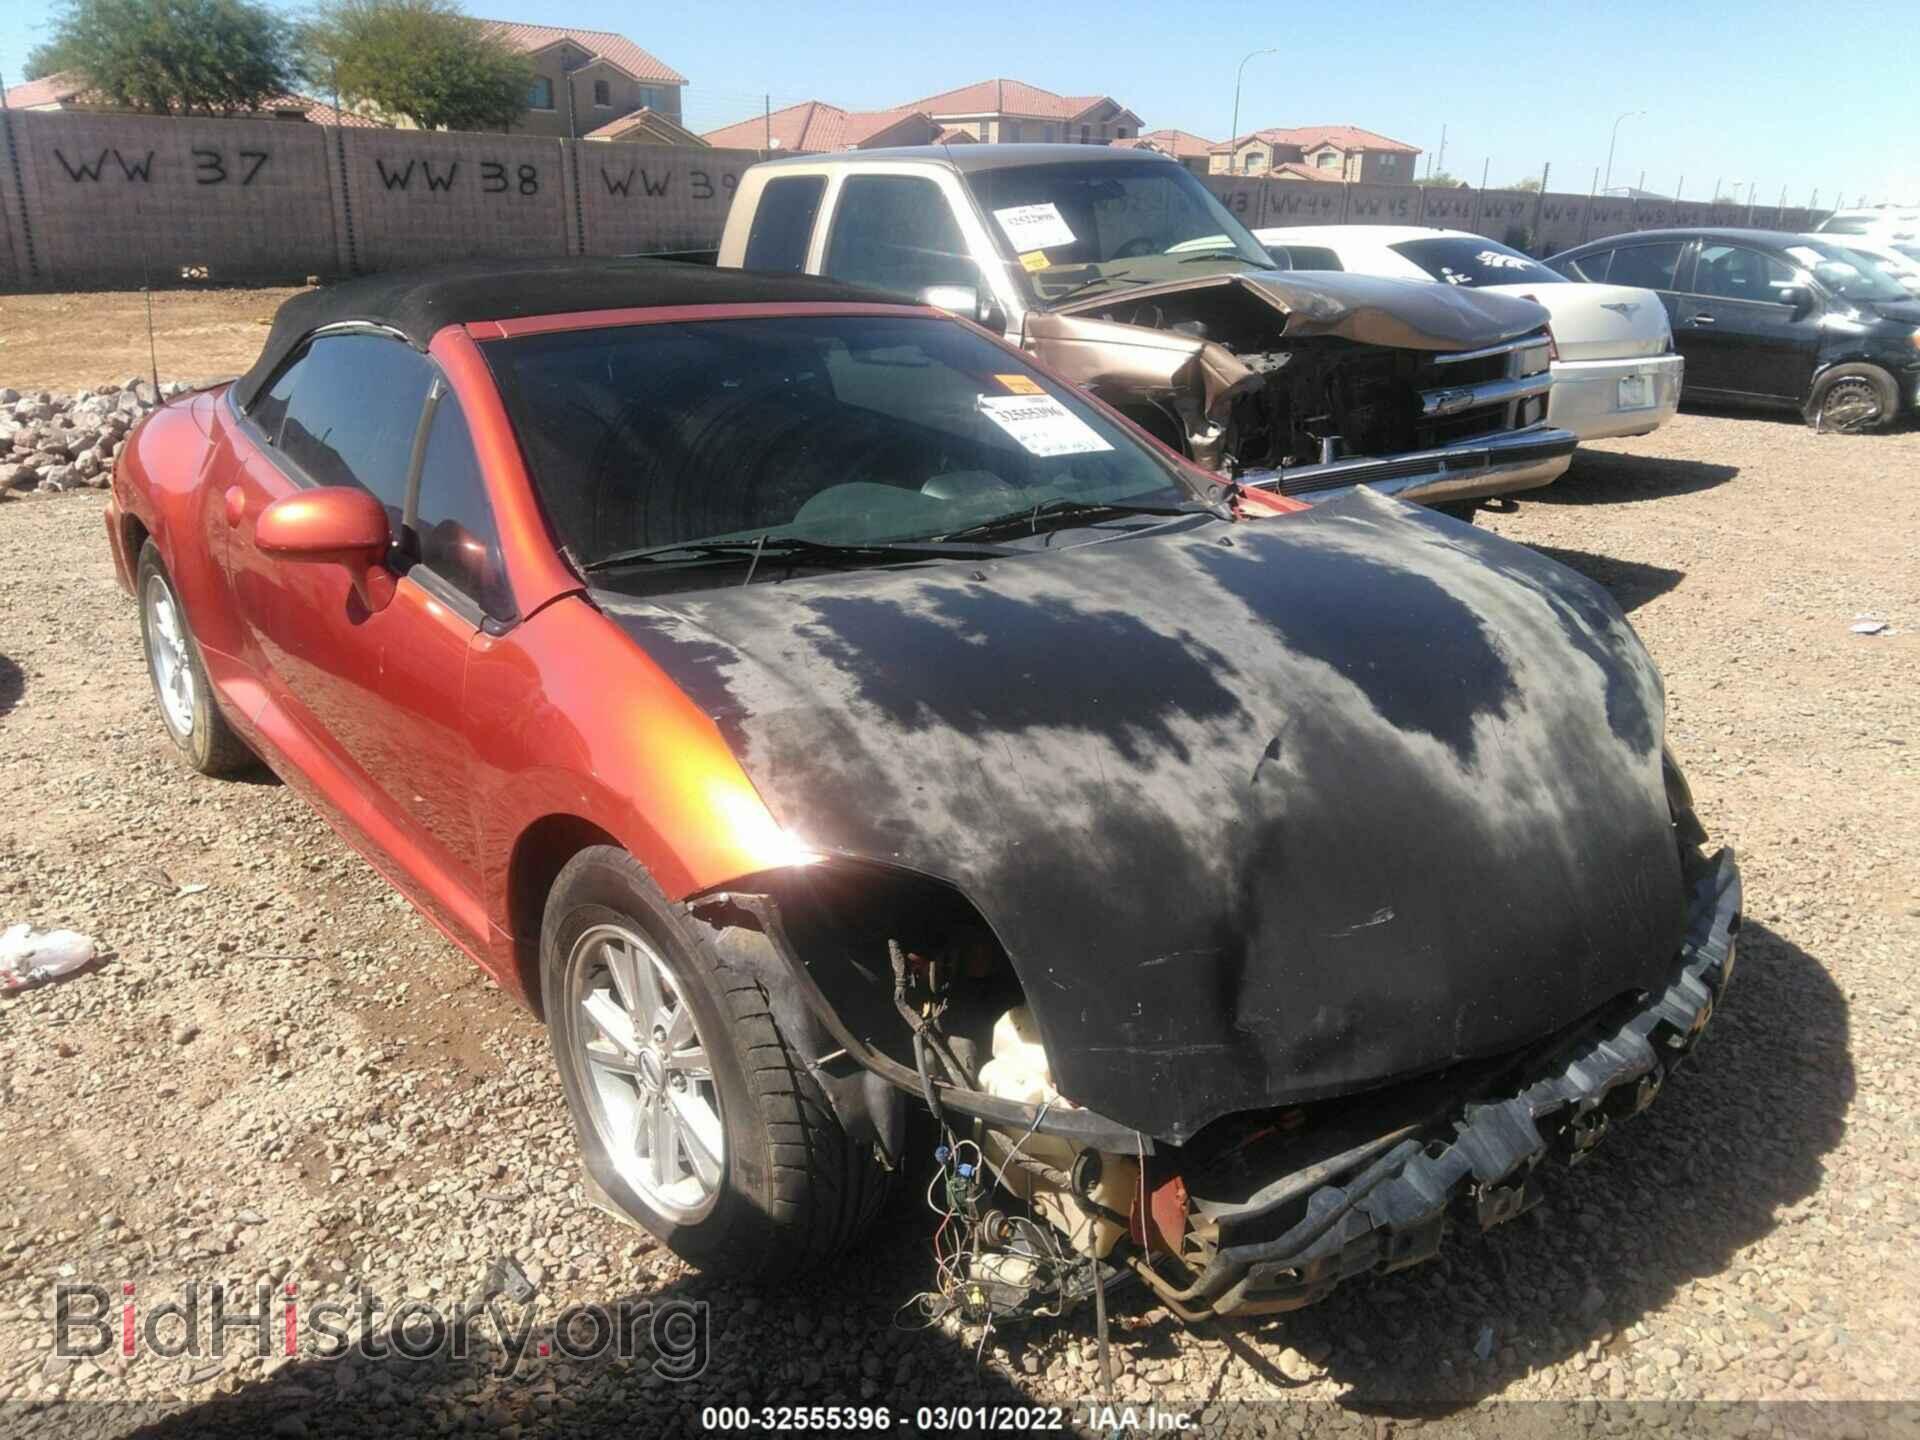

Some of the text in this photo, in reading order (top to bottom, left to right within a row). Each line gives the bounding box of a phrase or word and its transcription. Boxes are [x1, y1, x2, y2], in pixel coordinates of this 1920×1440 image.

[54, 147, 270, 186] WW 37
[376, 158, 540, 196] WW 38
[601, 167, 671, 197] WW
[1271, 193, 1330, 214] WW 44
